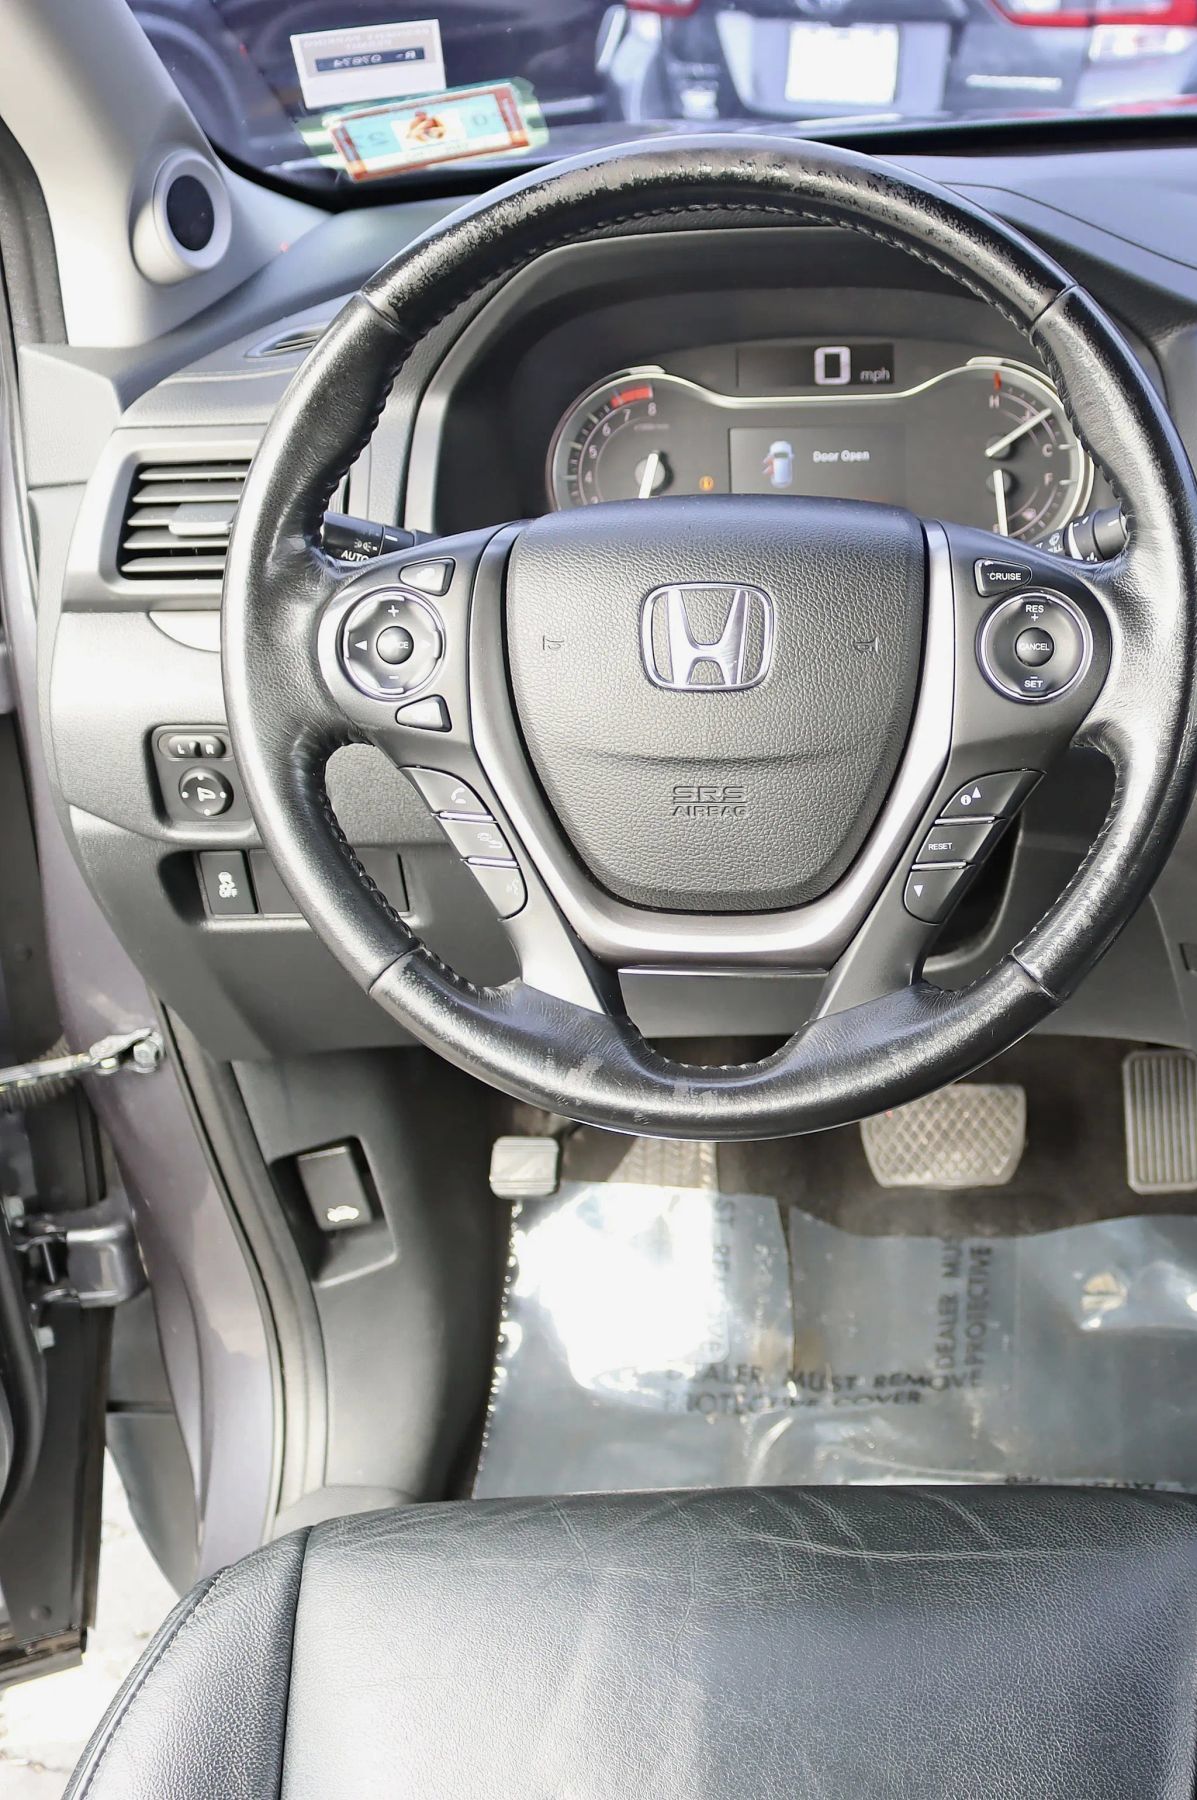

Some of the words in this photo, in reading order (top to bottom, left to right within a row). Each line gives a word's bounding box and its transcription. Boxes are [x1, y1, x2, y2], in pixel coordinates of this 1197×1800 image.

[814, 346, 851, 385] 0
[860, 367, 891, 383] mph
[623, 408, 631, 422] 7
[648, 402, 657, 416] 8
[602, 422, 611, 437] 6
[812, 451, 840, 463] Door
[840, 450, 870, 463] Open
[989, 572, 1022, 581] CRUISE
[1025, 604, 1044, 613] RES
[1019, 643, 1050, 651] CANCEL
[1024, 680, 1043, 688] SET
[672, 785, 746, 802] SRS
[672, 805, 747, 817] AIRBAG
[928, 842, 953, 851] RESET
[965, 1247, 992, 1367] PROTECTIVE
[933, 1292, 959, 1369] DEALER
[786, 1369, 857, 1393] MUST
[874, 1369, 983, 1391] REMOVE
